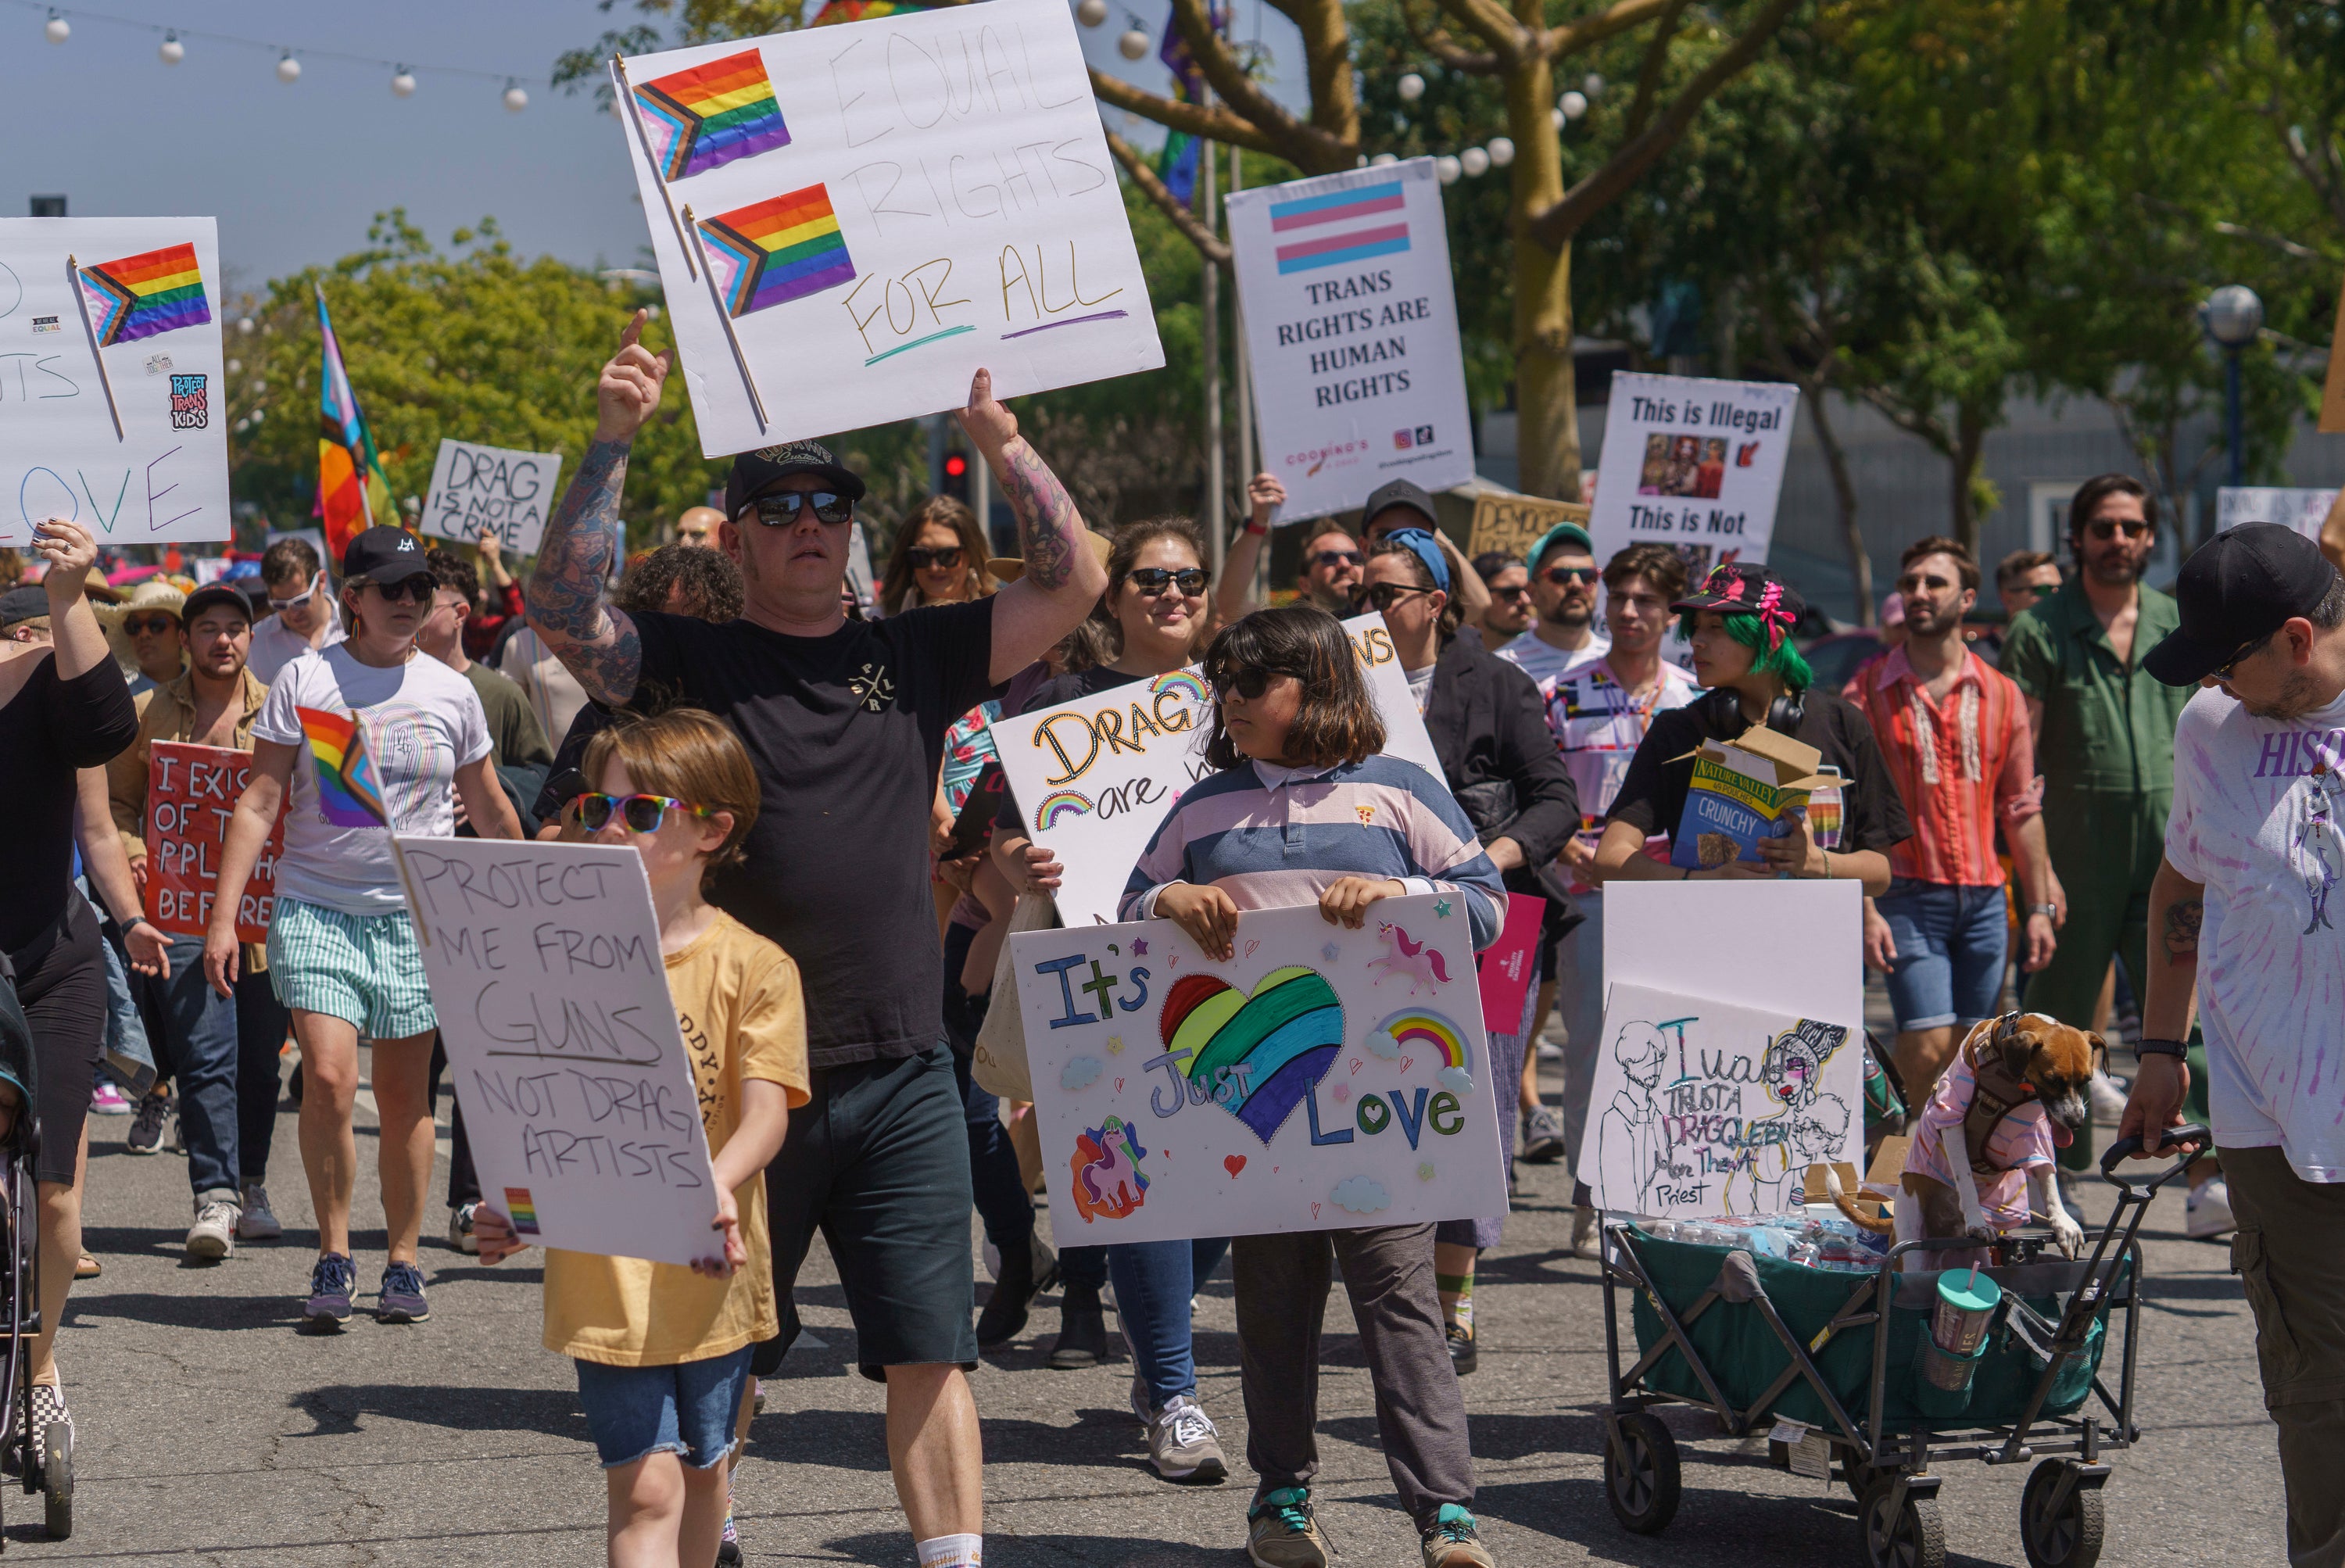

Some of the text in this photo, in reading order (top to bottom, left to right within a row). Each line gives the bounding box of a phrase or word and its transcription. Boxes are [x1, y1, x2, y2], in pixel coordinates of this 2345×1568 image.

[829, 23, 1083, 148] EQUAL
[841, 138, 1106, 237] RIGHTS
[843, 240, 1123, 354] FOR ALL
[1305, 270, 1393, 306] TRANS
[1277, 297, 1430, 347] RIGHTS ARE
[146, 360, 174, 374] TOGETHER
[1309, 336, 1407, 375] HUMAN
[172, 376, 205, 398] PROTECT
[172, 388, 206, 411] TRANS
[1315, 369, 1412, 408] RIGHTS
[1632, 396, 1782, 434] This is Illegal
[0, 446, 202, 539] OVE
[447, 447, 540, 502] DRAG
[435, 491, 541, 525] IS NOT A
[1630, 505, 1747, 535] This is Not
[397, 538, 414, 552] LA
[1033, 690, 1191, 786] DRAG
[159, 757, 178, 793] I
[1698, 760, 1738, 785] NATURE
[1739, 775, 1776, 805] VALLEY
[1722, 785, 1754, 805] POUCHES
[1097, 775, 1167, 820] are
[1698, 797, 1758, 836] CRUNCHY
[155, 803, 199, 836] OF
[159, 840, 218, 879] PPL
[406, 849, 621, 915] PROTECT
[158, 888, 274, 928] BEFRE
[436, 922, 656, 976] ME FROM
[1035, 942, 1151, 1029] It's
[474, 980, 663, 1063] GUNS
[1656, 1016, 1702, 1087] I
[473, 1067, 560, 1118] NOT
[565, 1068, 693, 1143] DRAG
[521, 1123, 702, 1188] ARTISTS
[1656, 1179, 1713, 1208] Priest
